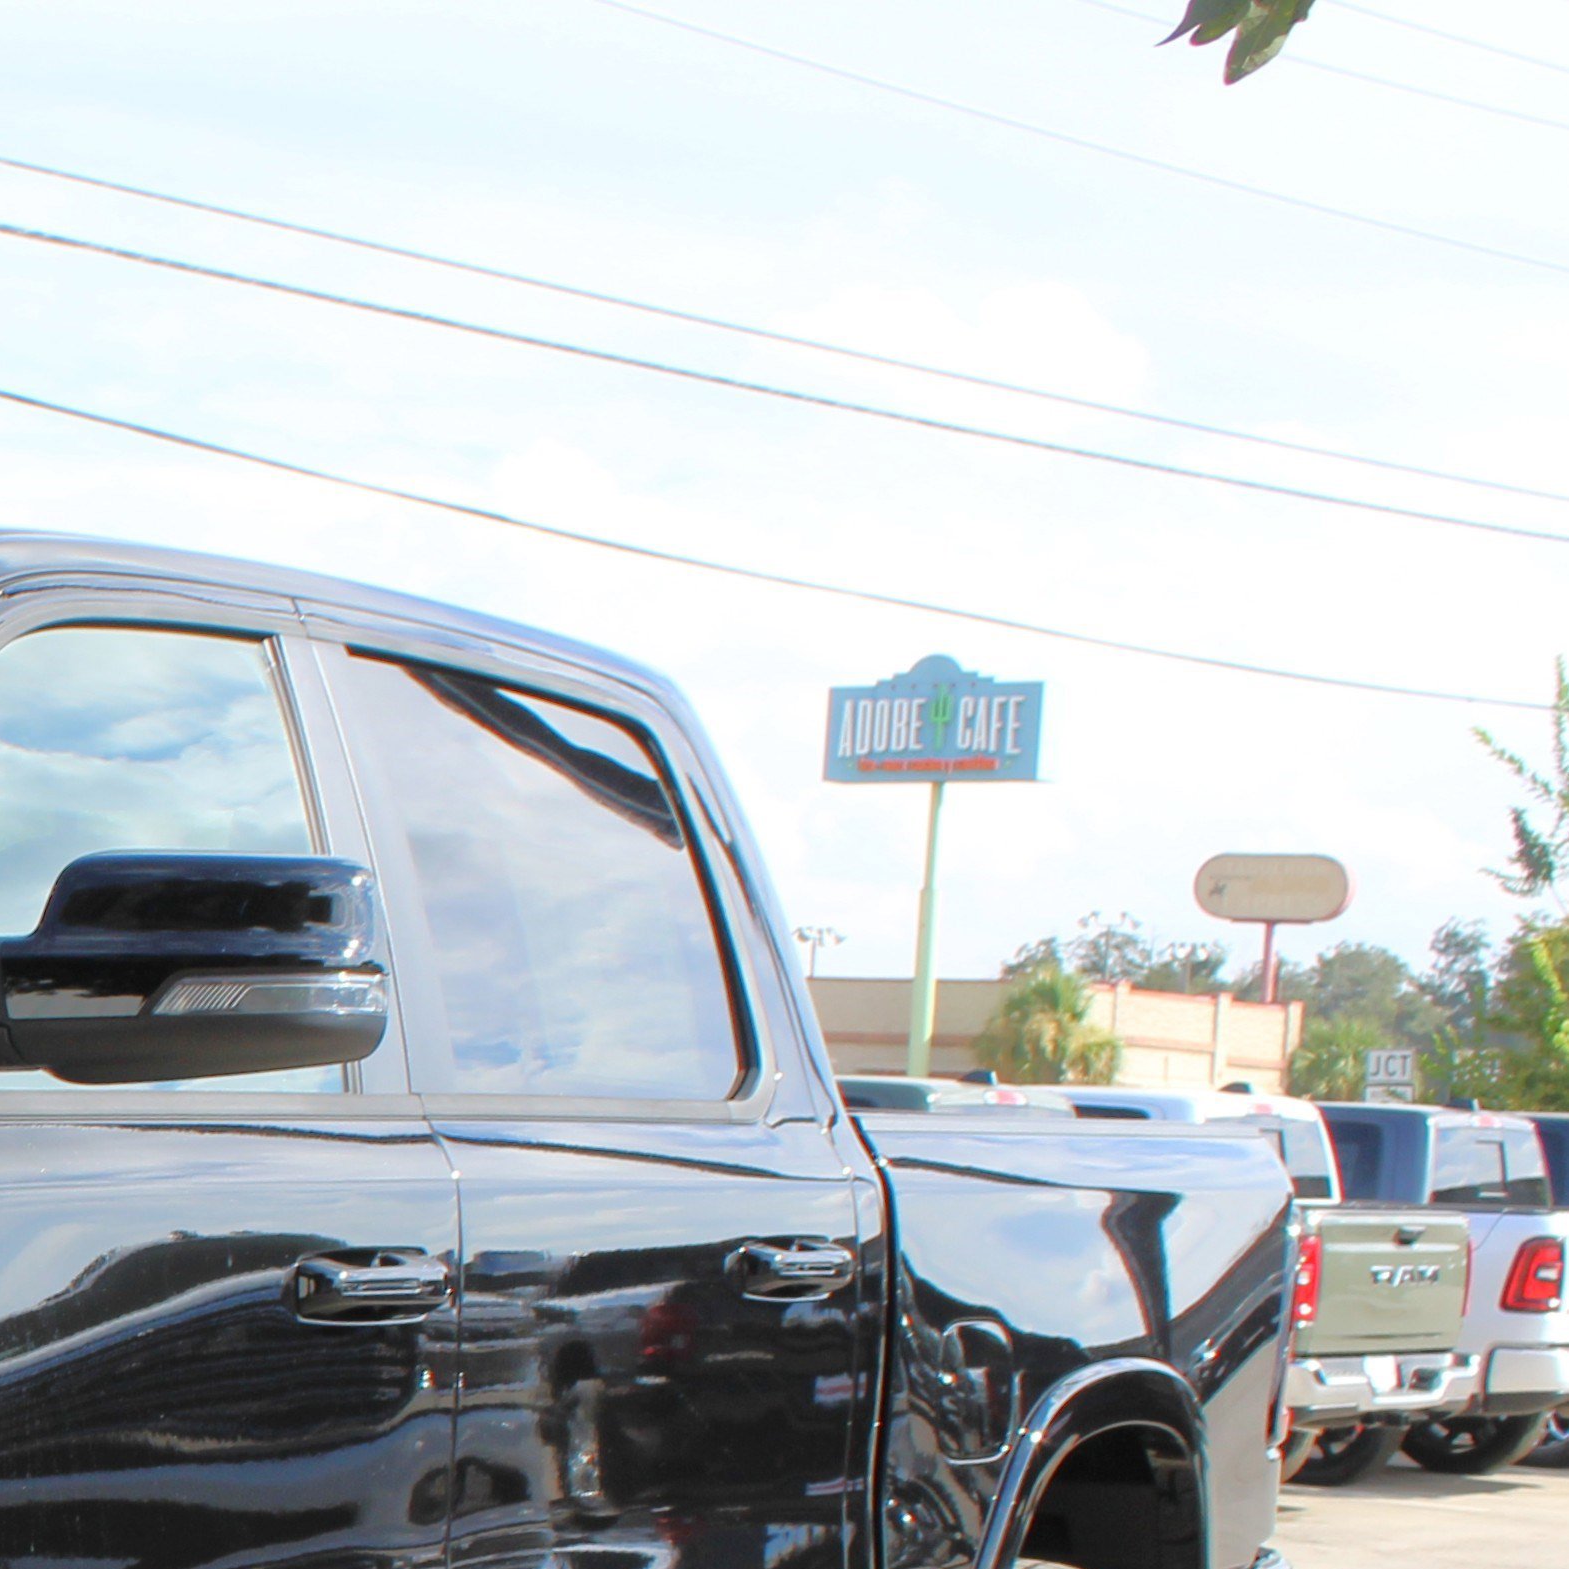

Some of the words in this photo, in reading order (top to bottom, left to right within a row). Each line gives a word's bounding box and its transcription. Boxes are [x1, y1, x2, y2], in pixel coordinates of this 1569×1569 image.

[838, 697, 927, 757] ADOBE
[956, 695, 1027, 754] CAFE
[1369, 1053, 1412, 1077] JCT
[1369, 1265, 1441, 1287] RAM
